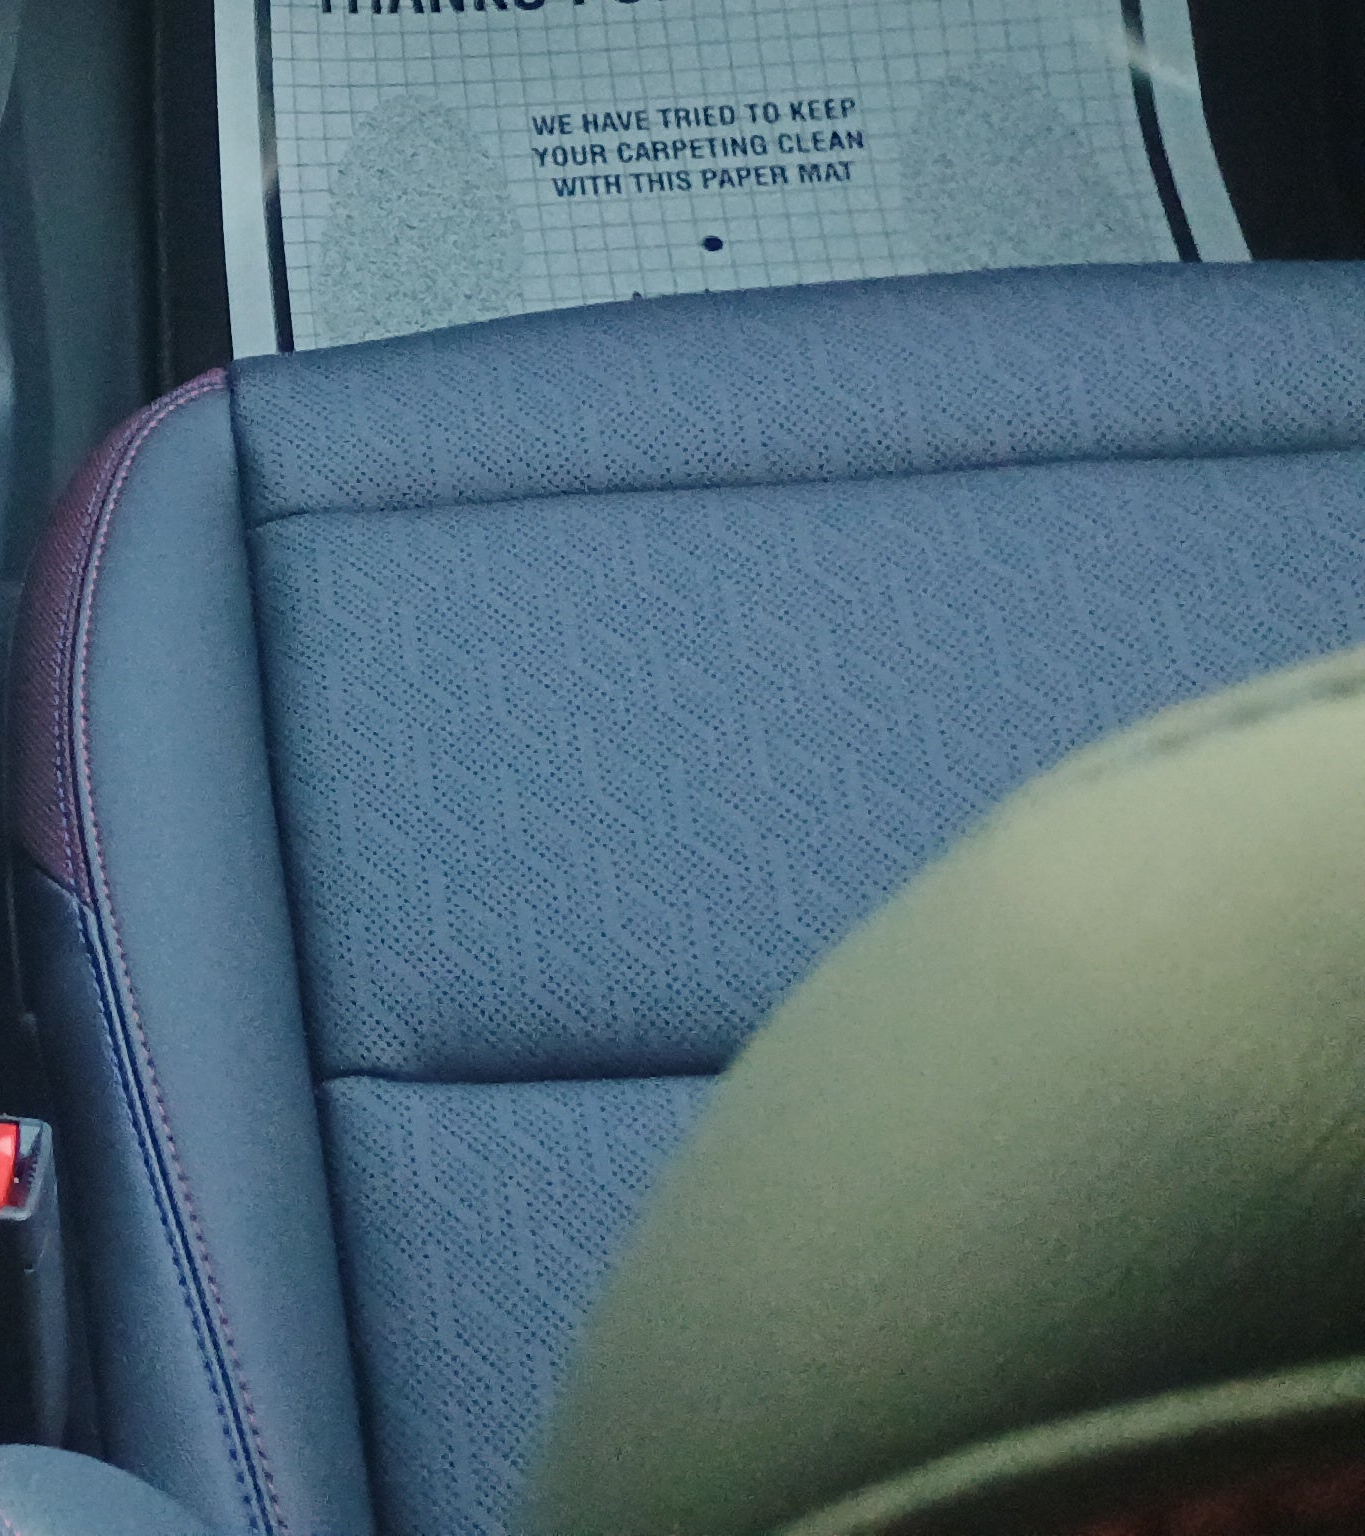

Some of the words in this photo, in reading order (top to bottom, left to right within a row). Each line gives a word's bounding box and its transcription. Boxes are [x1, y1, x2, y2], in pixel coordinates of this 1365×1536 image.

[531, 113, 573, 136] WE
[582, 110, 650, 134] HAVE
[657, 104, 736, 130] TRIED
[744, 101, 781, 124] TO
[789, 96, 857, 123] KEEP
[531, 143, 607, 167] YOUR
[619, 133, 767, 164] CARPETING
[777, 129, 865, 155] CLEAN
[552, 173, 622, 198] WITH
[630, 168, 692, 193] THIS
[702, 164, 790, 190] PAPER
[799, 160, 855, 184] MAT
